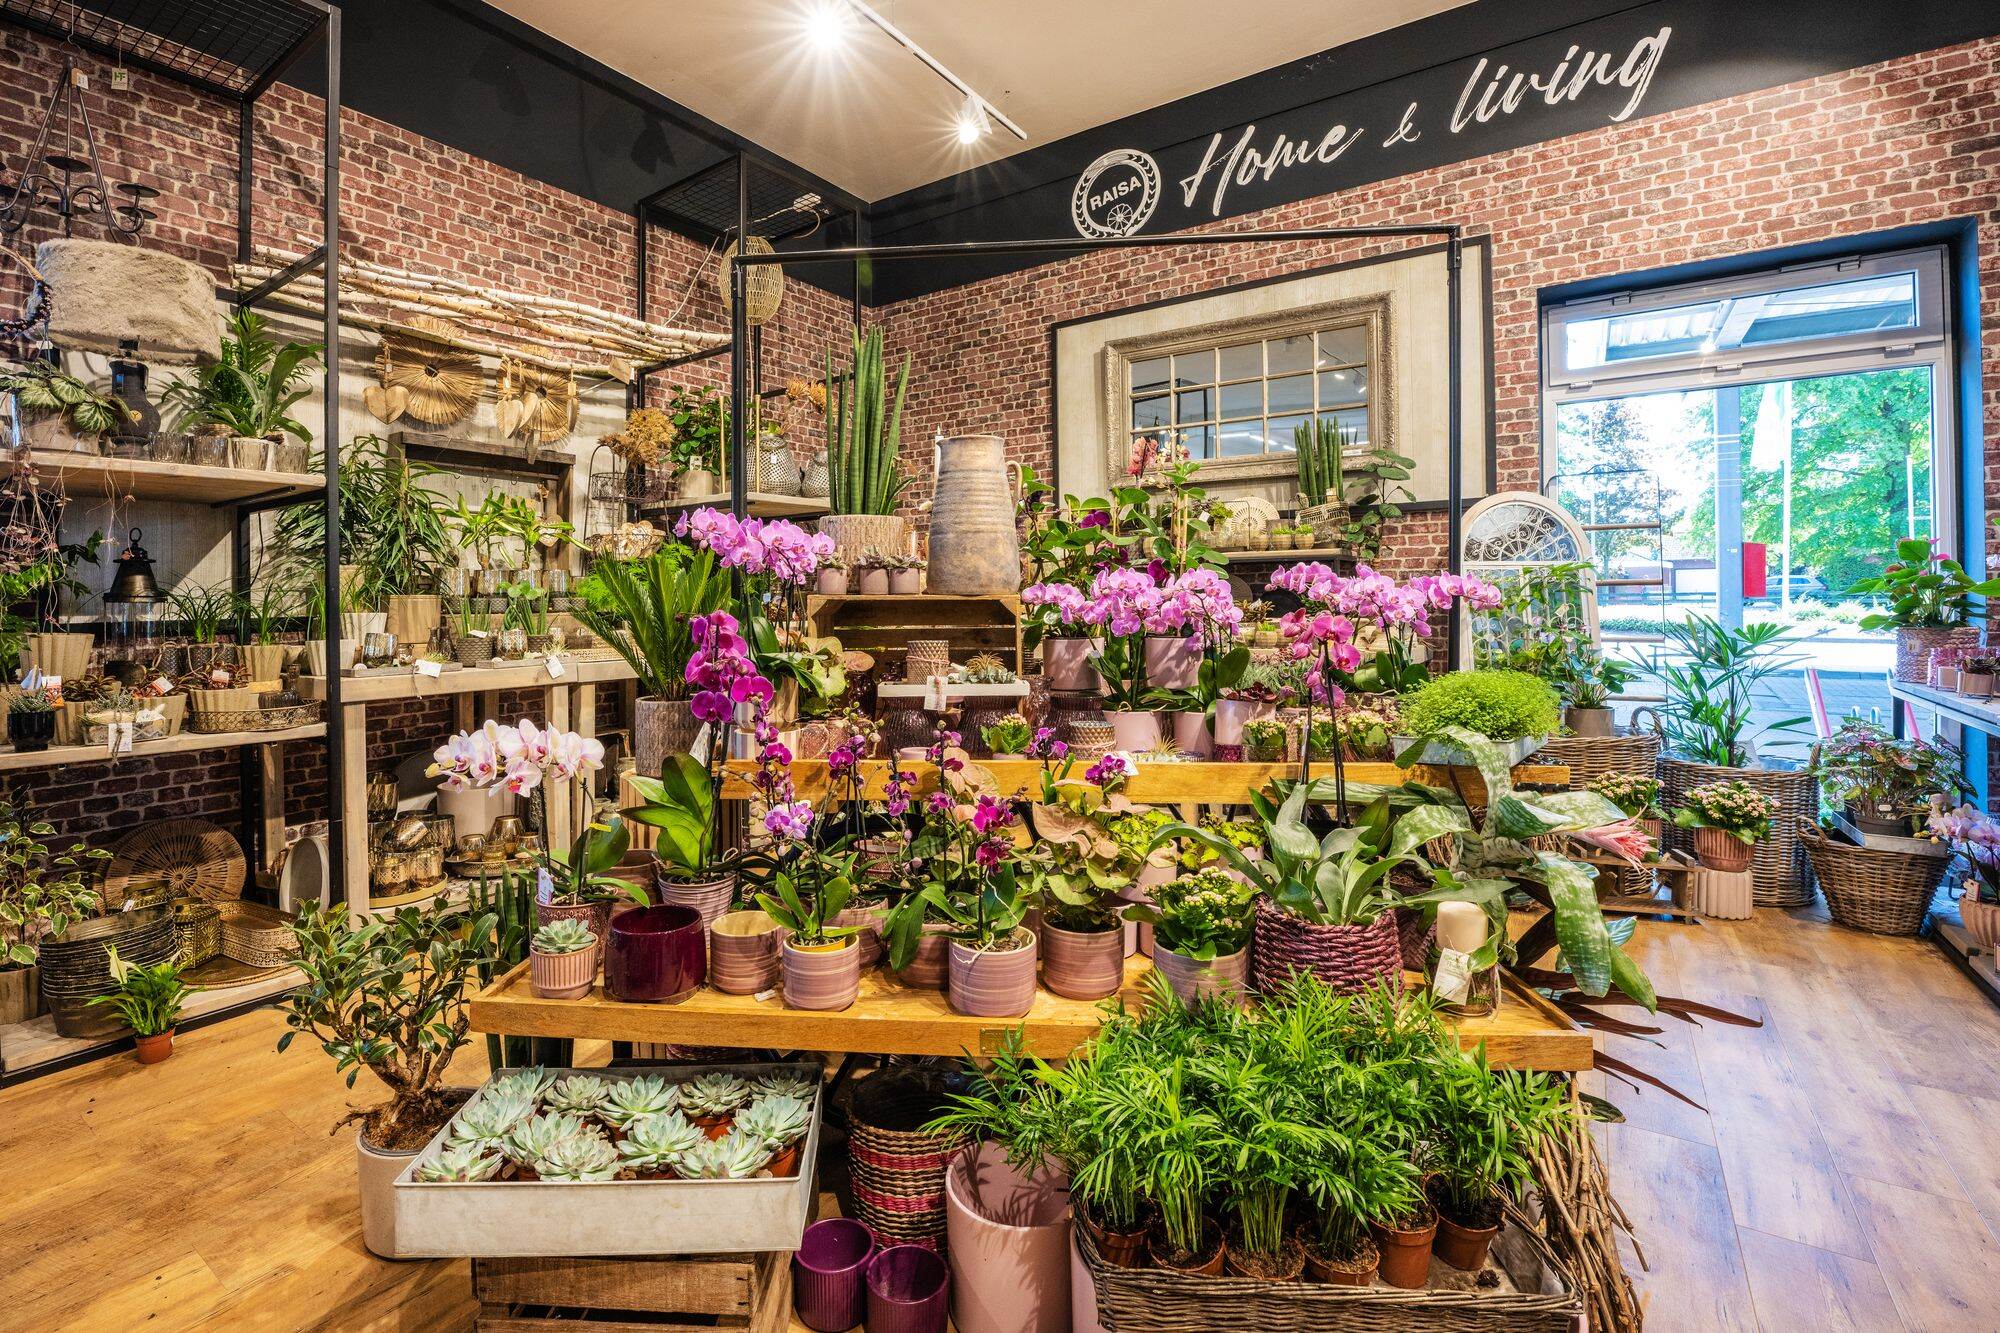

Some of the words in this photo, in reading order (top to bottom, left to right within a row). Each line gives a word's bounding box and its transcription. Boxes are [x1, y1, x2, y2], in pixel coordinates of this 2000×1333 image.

[1179, 125, 1364, 216] Home
[1383, 102, 1421, 147] &
[1450, 27, 1672, 134] living
[1090, 176, 1141, 211] RAISA
